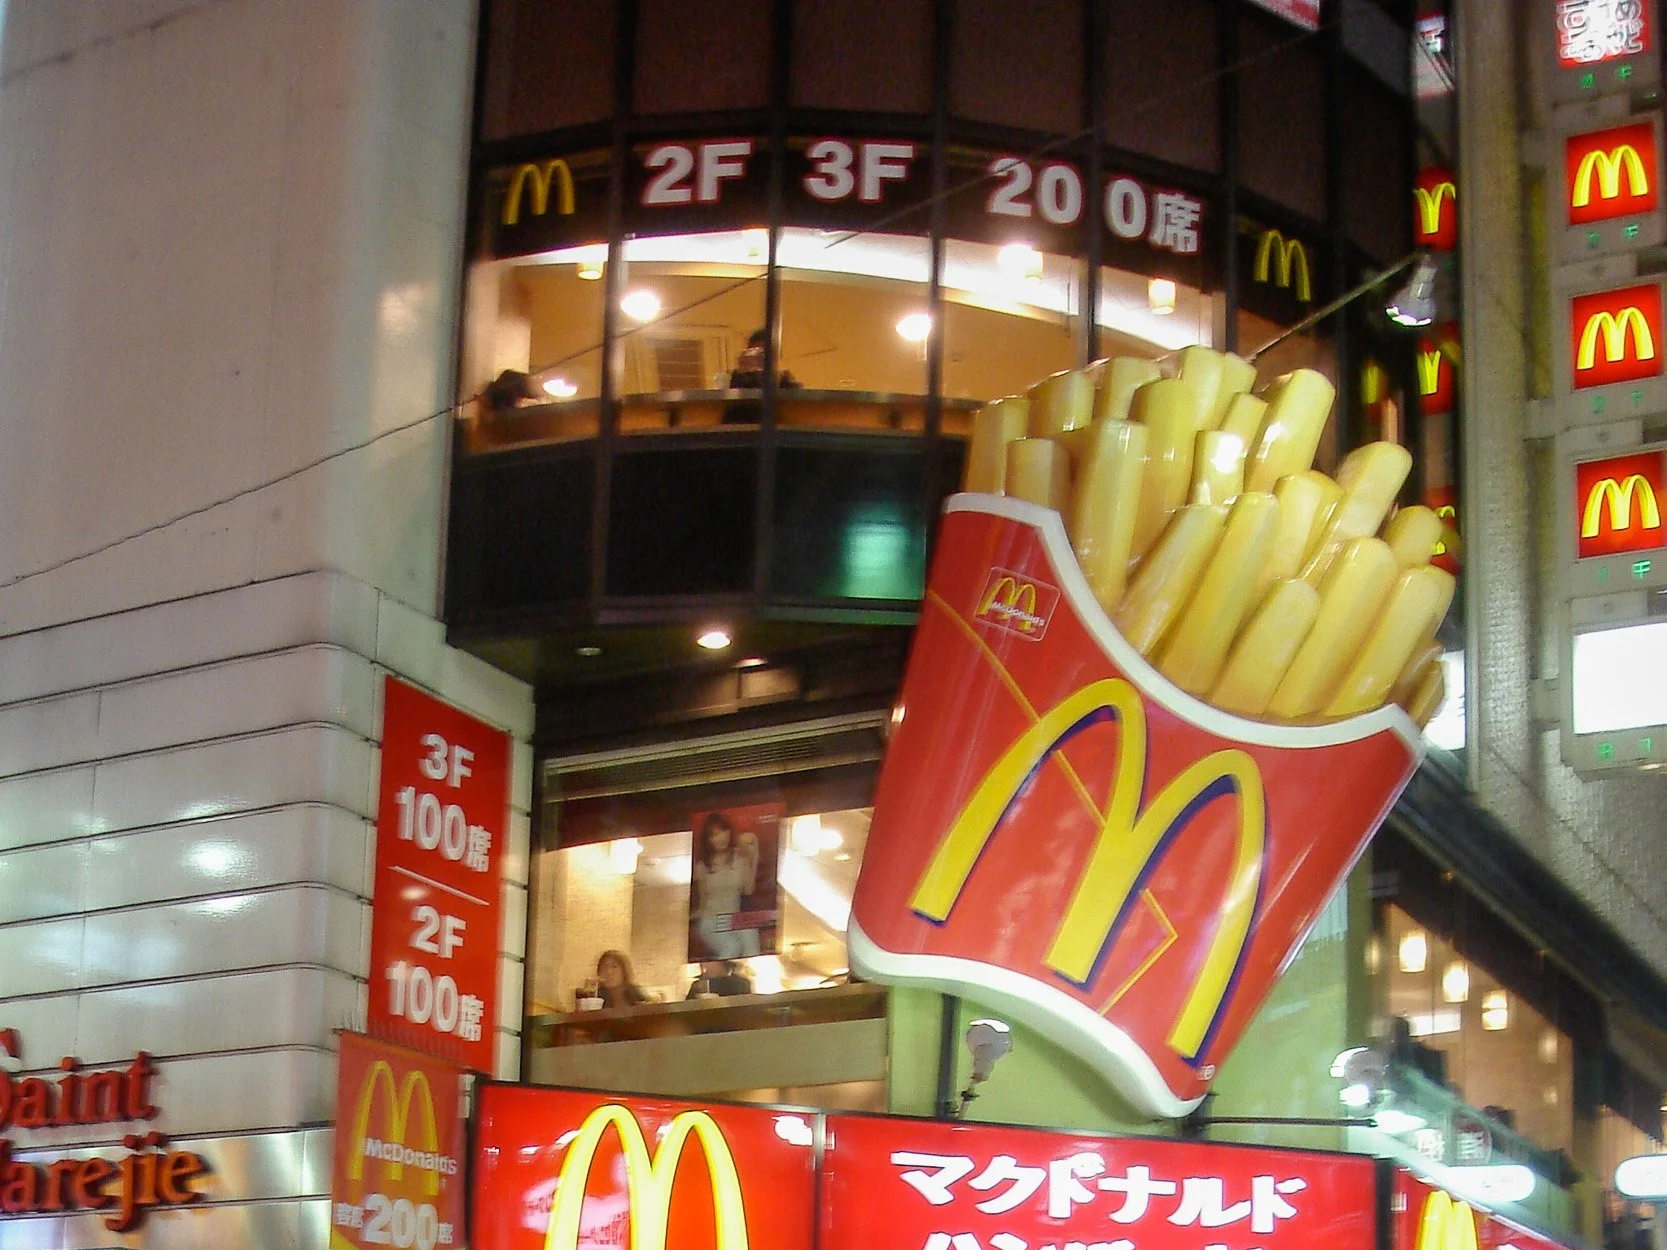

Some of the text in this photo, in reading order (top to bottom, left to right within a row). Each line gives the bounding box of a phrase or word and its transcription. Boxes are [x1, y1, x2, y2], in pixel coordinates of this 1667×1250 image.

[643, 140, 1201, 253] 2F 3F 200席
[420, 733, 474, 788] 3F
[396, 786, 491, 872] 100席
[410, 905, 466, 959] 2F
[386, 961, 483, 1042] 100席
[0, 1131, 207, 1231] arejie
[890, 1151, 1307, 1234] マクドナルド
